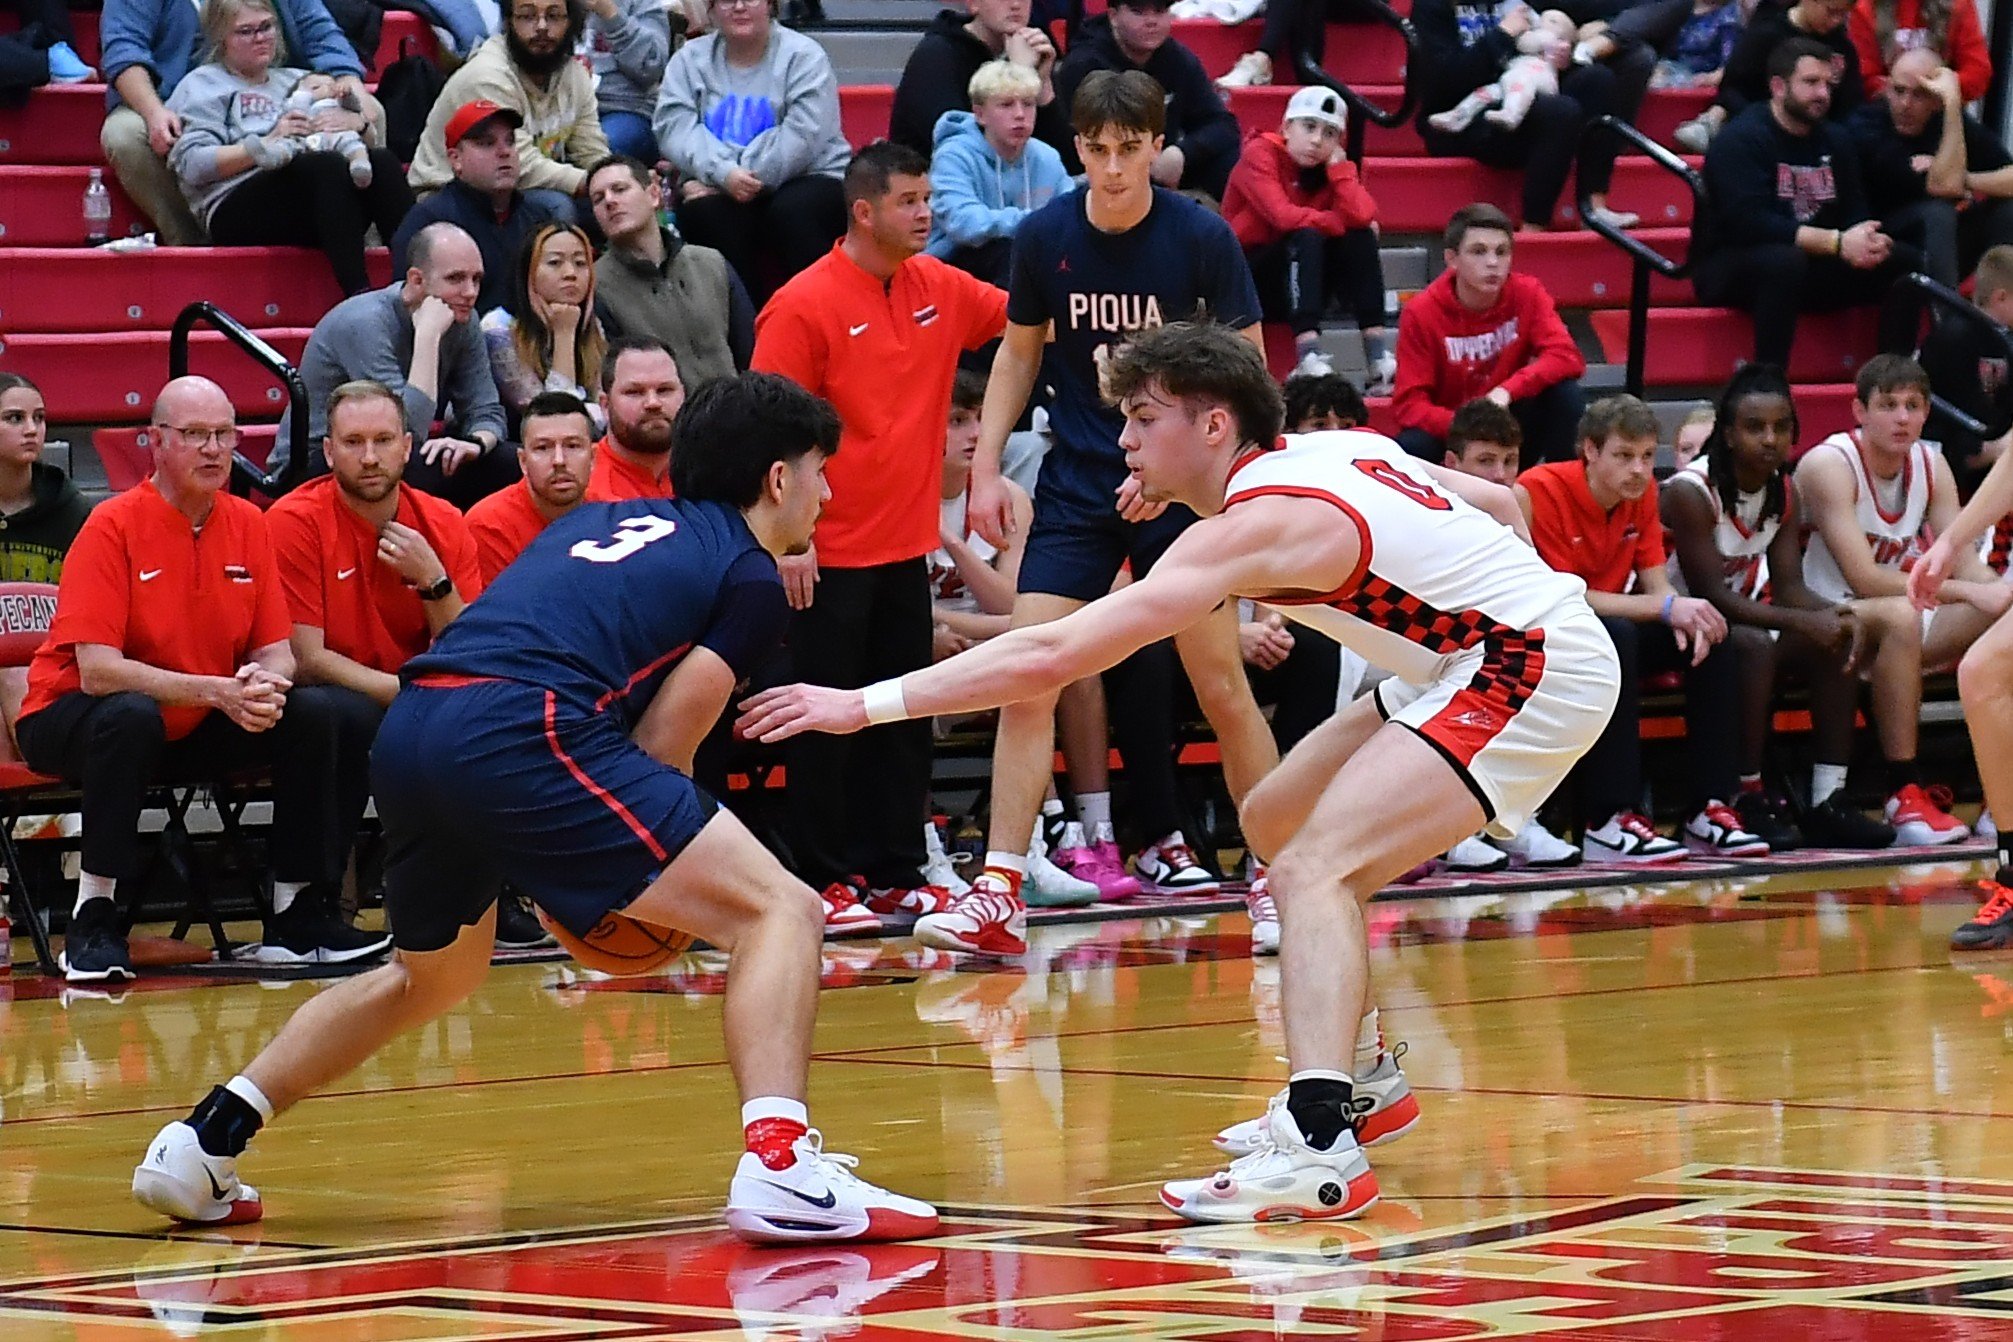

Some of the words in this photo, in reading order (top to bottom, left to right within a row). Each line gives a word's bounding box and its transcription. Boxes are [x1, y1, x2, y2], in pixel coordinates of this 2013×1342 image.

[1069, 293, 1163, 332] PIQUA
[1351, 458, 1453, 511] 0
[569, 514, 677, 563] 3
